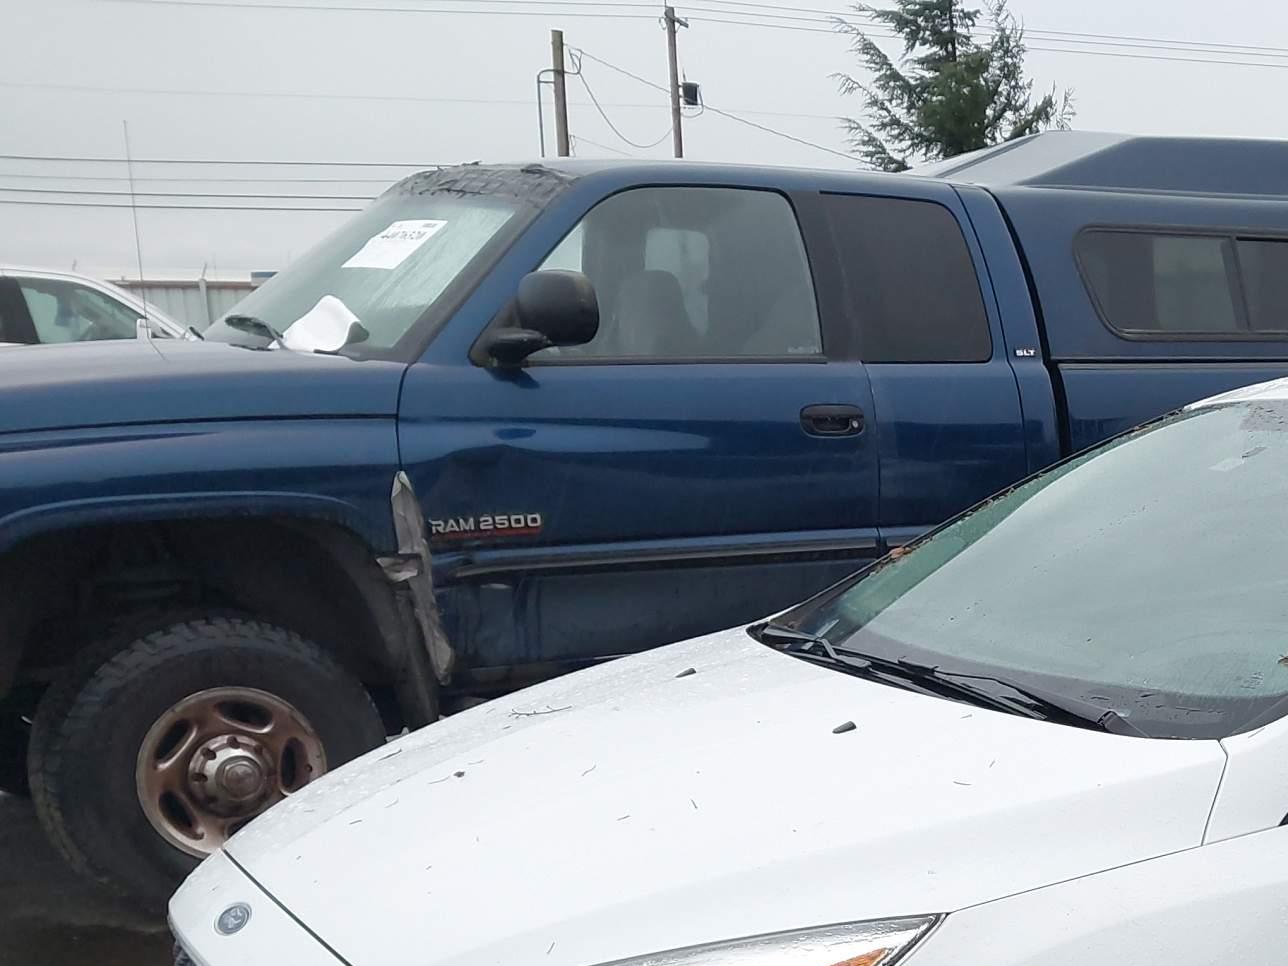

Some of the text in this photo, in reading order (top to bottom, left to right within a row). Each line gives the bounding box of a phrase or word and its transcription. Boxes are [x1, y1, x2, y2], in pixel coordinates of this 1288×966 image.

[1015, 348, 1036, 357] SLT
[428, 512, 542, 534] RAM 2500
